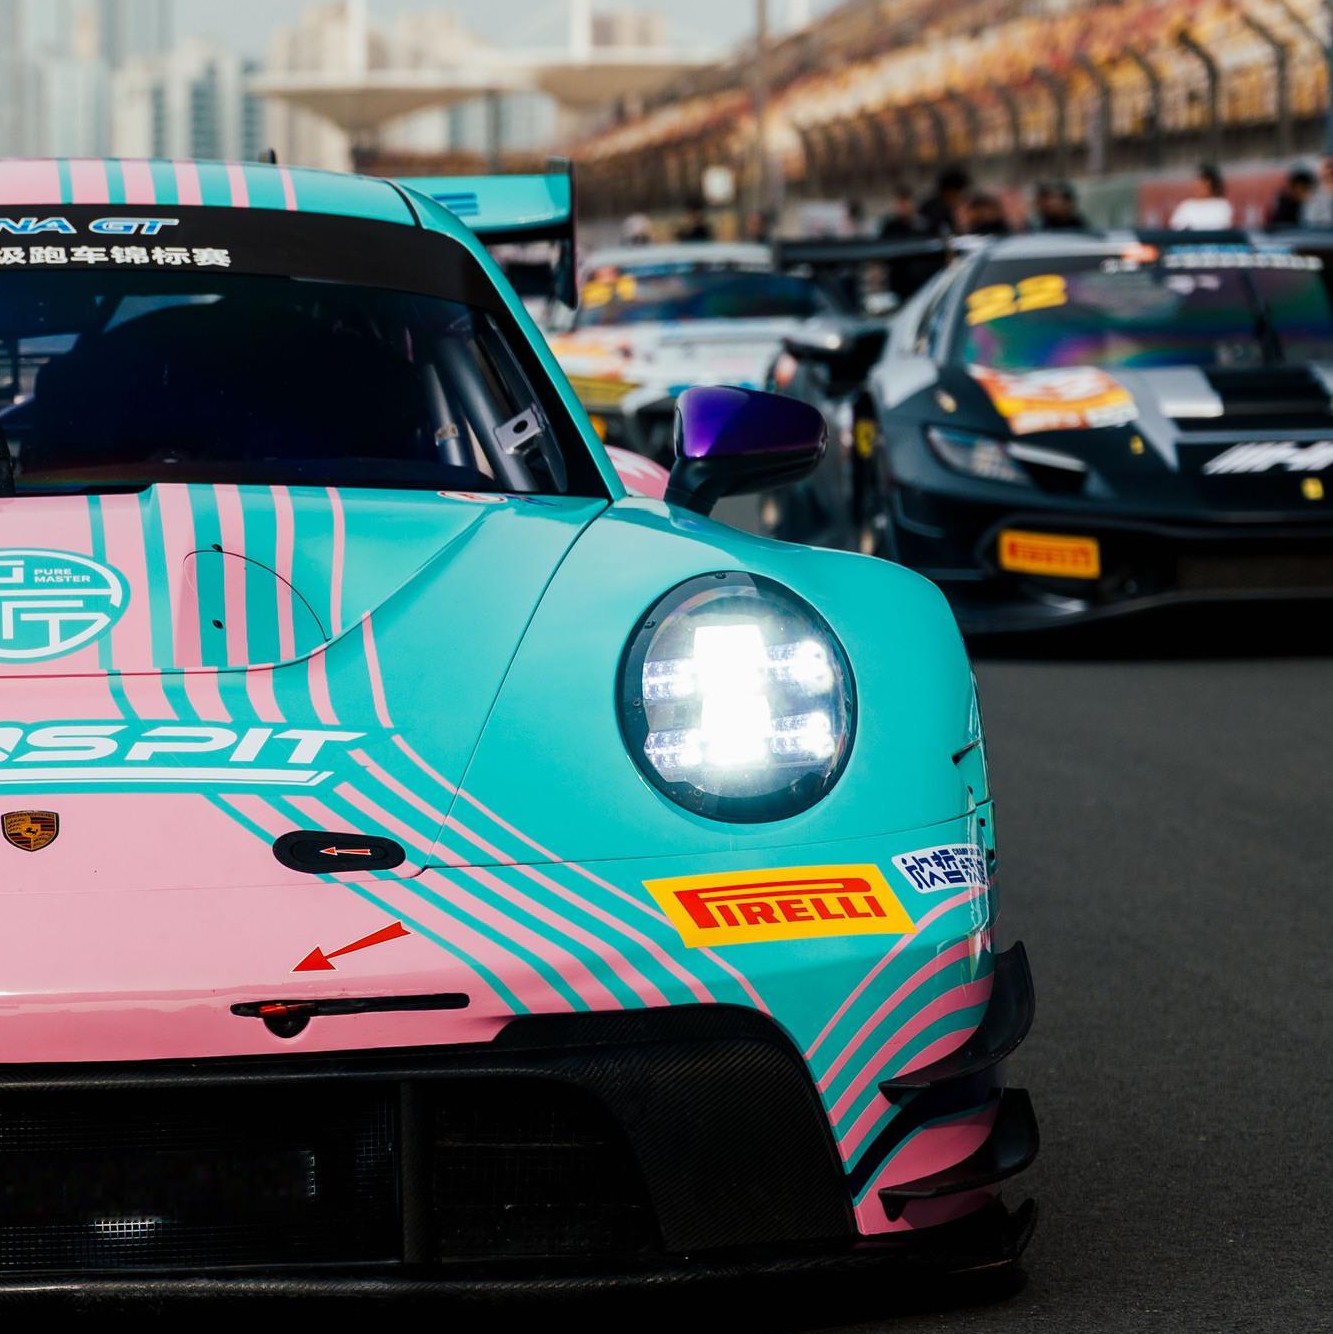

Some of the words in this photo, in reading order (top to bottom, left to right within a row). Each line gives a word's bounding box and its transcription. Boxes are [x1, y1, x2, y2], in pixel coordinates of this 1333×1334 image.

[88, 217, 179, 235] GT
[34, 568, 72, 576] PURE
[34, 575, 91, 583] MASTER
[673, 877, 887, 930] PIRELLI
